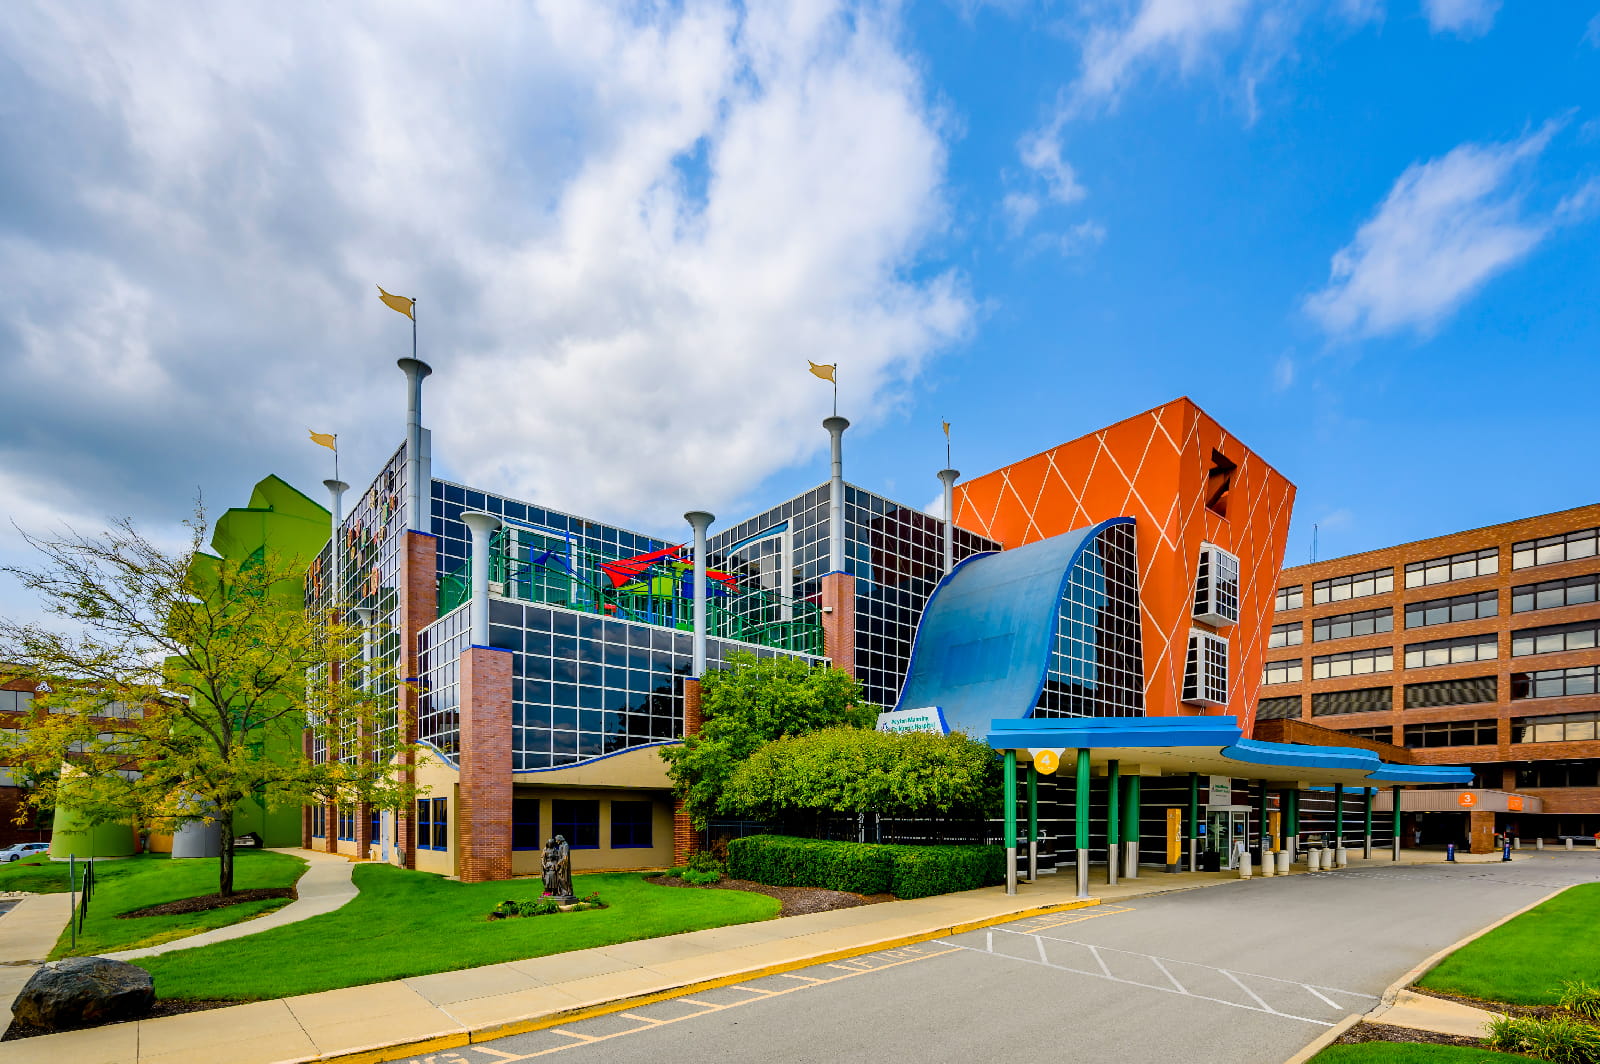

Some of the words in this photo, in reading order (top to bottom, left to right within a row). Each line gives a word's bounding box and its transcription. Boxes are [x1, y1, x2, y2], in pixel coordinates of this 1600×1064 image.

[1041, 754, 1050, 765] 4
[1464, 794, 1471, 802] 3
[846, 946, 935, 968] FIRE
